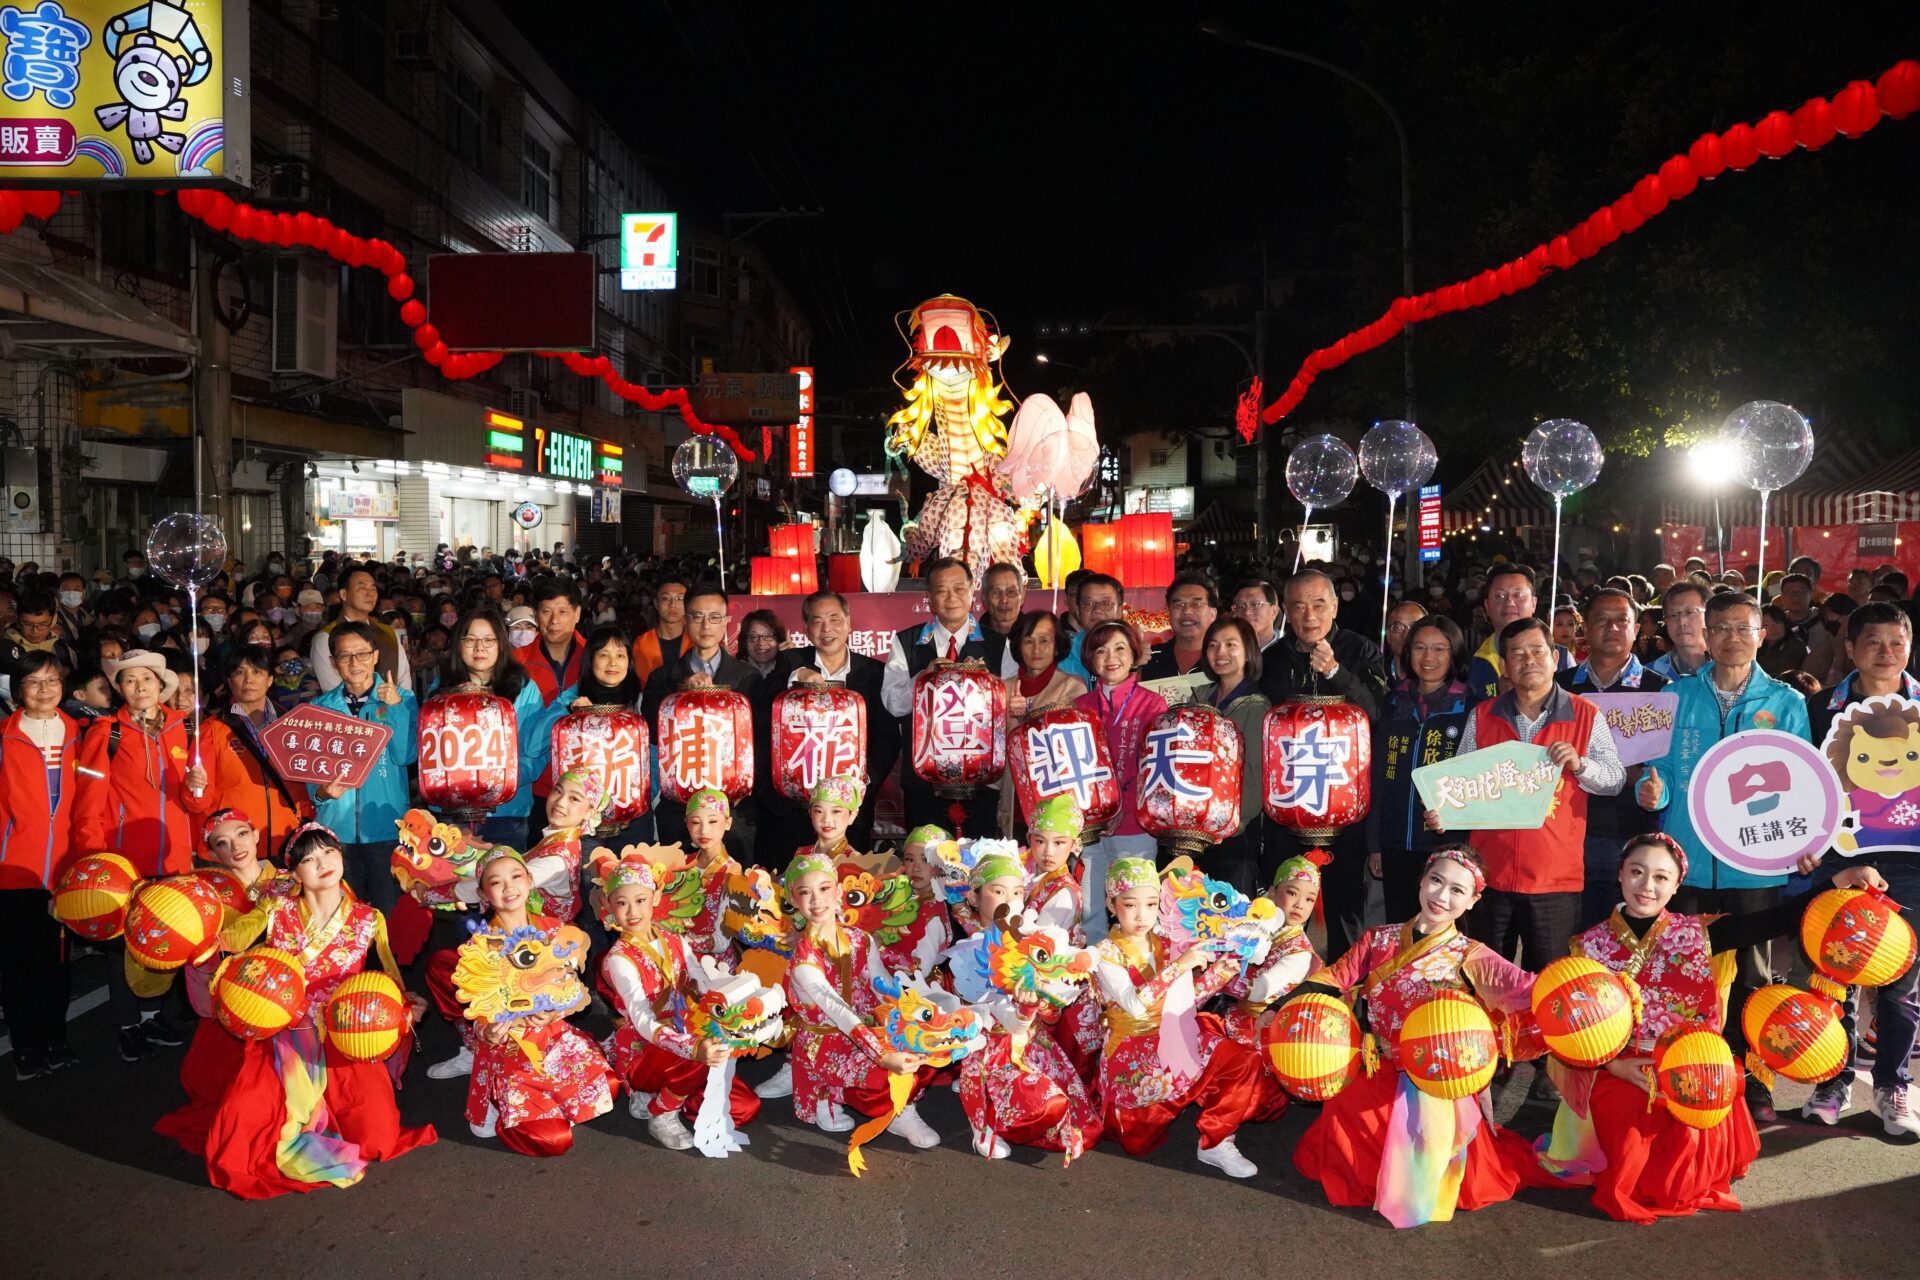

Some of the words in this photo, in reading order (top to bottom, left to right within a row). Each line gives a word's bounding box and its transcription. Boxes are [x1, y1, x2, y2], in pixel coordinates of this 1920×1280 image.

[0, 0, 92, 109] 寶
[1, 125, 62, 155] 販賣
[285, 733, 368, 758] 喜慶龍年
[421, 725, 507, 773] 2024
[788, 710, 860, 789] 花
[915, 678, 990, 768] 燈
[293, 758, 353, 778] 迎天穿
[1027, 722, 1112, 810] 迎
[1137, 722, 1214, 810] 天
[1269, 720, 1352, 817] 穿
[1435, 759, 1556, 809] 天穿日花燈踩街
